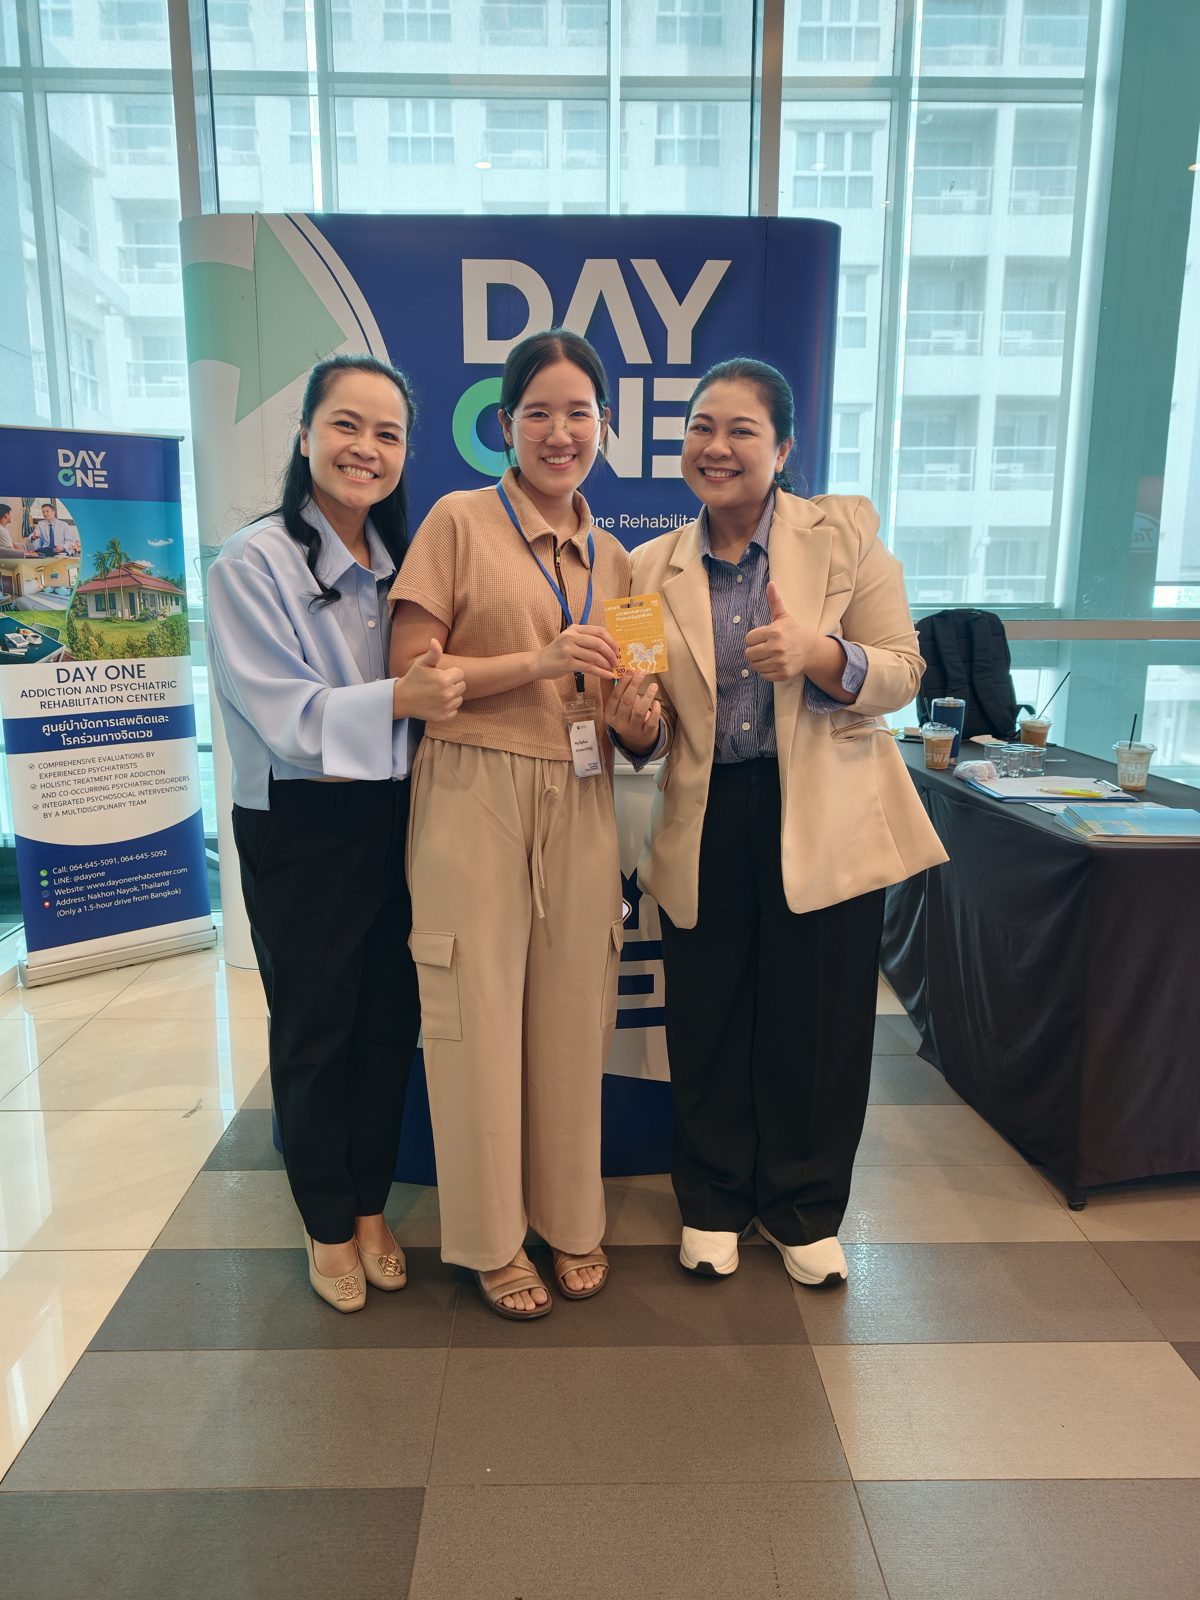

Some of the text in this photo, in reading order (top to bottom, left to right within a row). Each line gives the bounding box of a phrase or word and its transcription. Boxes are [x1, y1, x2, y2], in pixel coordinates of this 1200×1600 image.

[462, 258, 732, 365] DAY
[57, 448, 107, 469] DAY
[57, 468, 109, 489] ONE
[56, 664, 146, 684] DAY ONE
[20, 681, 177, 698] ADDICTION AND PSYCHIATRIC
[40, 693, 165, 709] REHABILITATION CENTER
[42, 713, 169, 736] ศูนย์บำบัดการเสพติดและ
[61, 728, 153, 746] โรคร่วมทางจิตเวช
[38, 757, 96, 769] COMPREHENSIVE
[98, 752, 144, 763] EVALUATIONS
[39, 763, 138, 779] EXPERIENCED PSYCHIATRISTS
[40, 780, 71, 789] HOLISTIC
[74, 775, 112, 785] TREATMENT
[130, 769, 166, 778] ADDICTION
[41, 776, 190, 799] AND CO-OCCURRING PSYCHIATRIC DISORDERS
[42, 785, 188, 809] INTEGRATED PSYCHOSOCIAL INTERVENTIONS
[62, 802, 126, 816] MULTIDISCIPLINARY
[129, 799, 147, 807] TEAM
[53, 865, 68, 874] Call:
[121, 850, 167, 863] 064-645-5092
[54, 870, 106, 885] LINE: @dayone
[54, 867, 188, 896] Website: www.dayonerehabcenter.com
[56, 880, 169, 906] Address: Nakhon Nayok, Thailand
[57, 907, 76, 918] (Only
[84, 901, 113, 912] 1.5-hour
[114, 896, 132, 906] drive
[133, 894, 149, 903] from
[151, 887, 182, 900] Bangkok)
